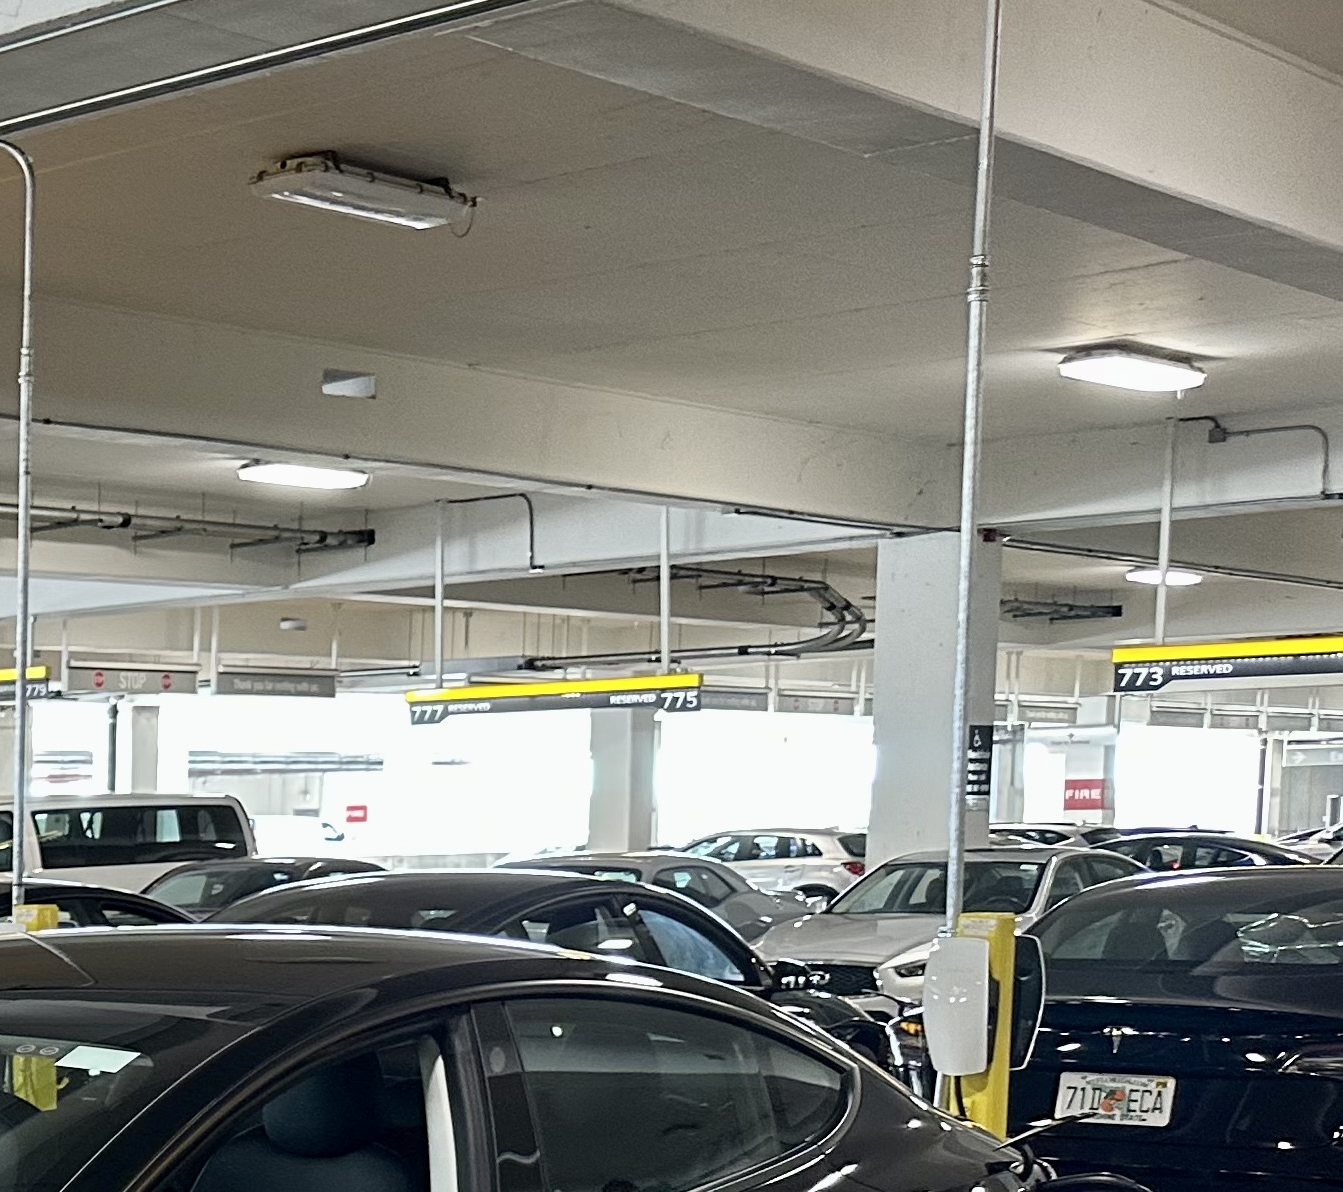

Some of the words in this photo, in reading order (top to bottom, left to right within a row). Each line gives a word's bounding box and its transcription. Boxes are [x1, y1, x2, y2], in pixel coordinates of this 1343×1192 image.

[118, 671, 147, 690] STOP
[1117, 666, 1164, 687] 773
[1171, 663, 1234, 676] RESERVED
[609, 693, 657, 705] RESERVED
[660, 690, 698, 710] 775
[411, 704, 444, 722] 777
[1065, 788, 1103, 800] FIRE
[1126, 1089, 1164, 1114] ECA
